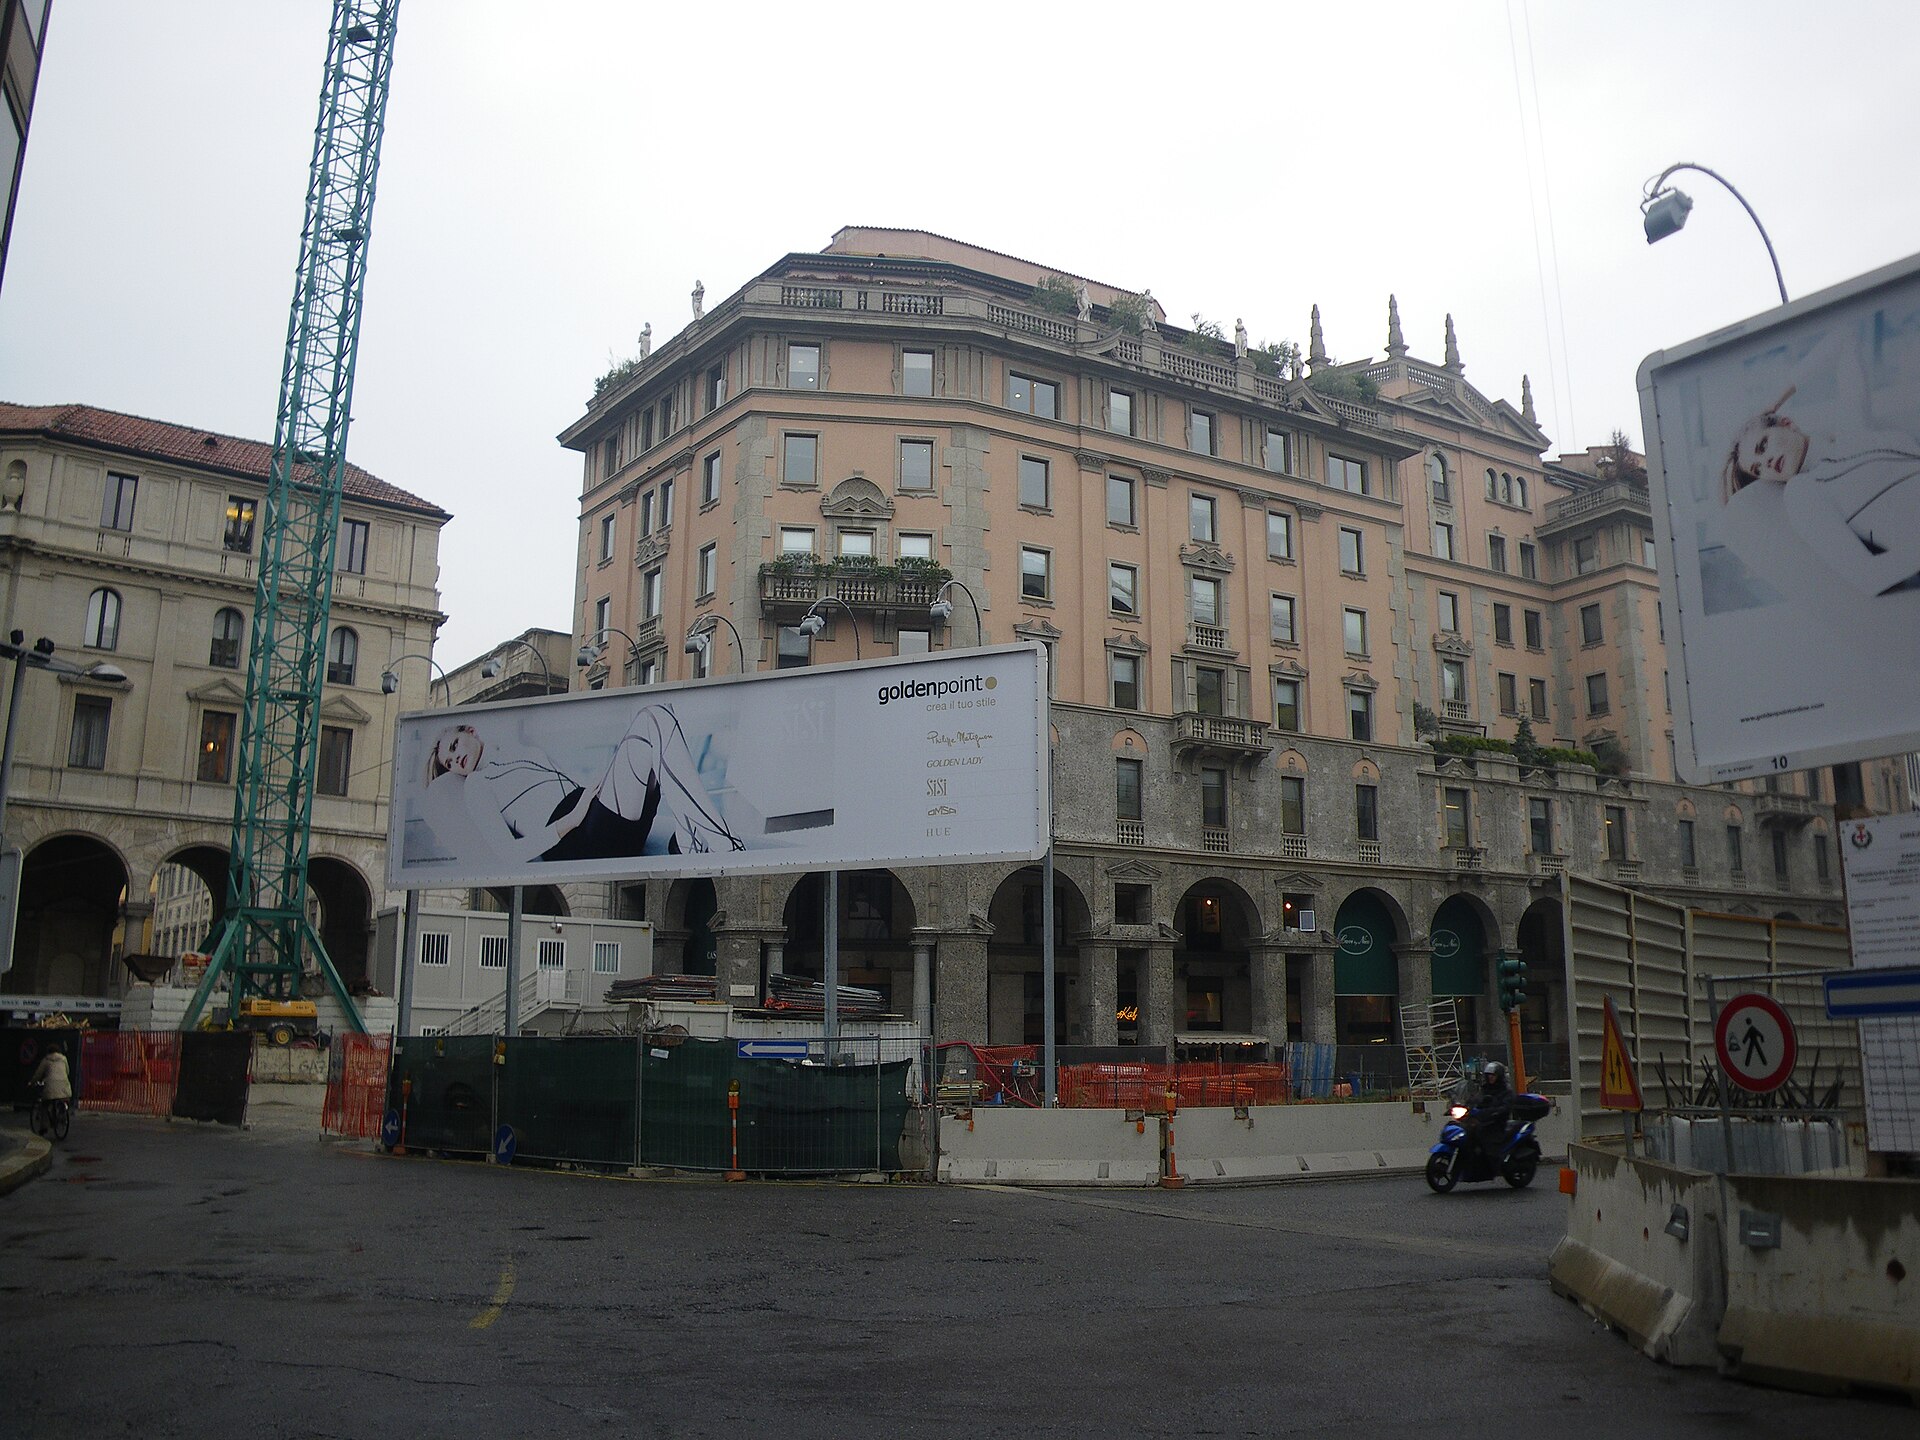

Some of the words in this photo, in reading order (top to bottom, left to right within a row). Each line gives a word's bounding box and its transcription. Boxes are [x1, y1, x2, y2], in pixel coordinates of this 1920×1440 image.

[878, 675, 983, 705] goldenpoint
[926, 703, 947, 712] crea
[949, 701, 955, 710] il
[957, 700, 973, 709] tuo
[976, 697, 996, 707] stile
[926, 758, 960, 768] GOLDEN
[961, 756, 984, 766] LADY
[1771, 755, 1788, 769] 10
[926, 827, 951, 837] HUE
